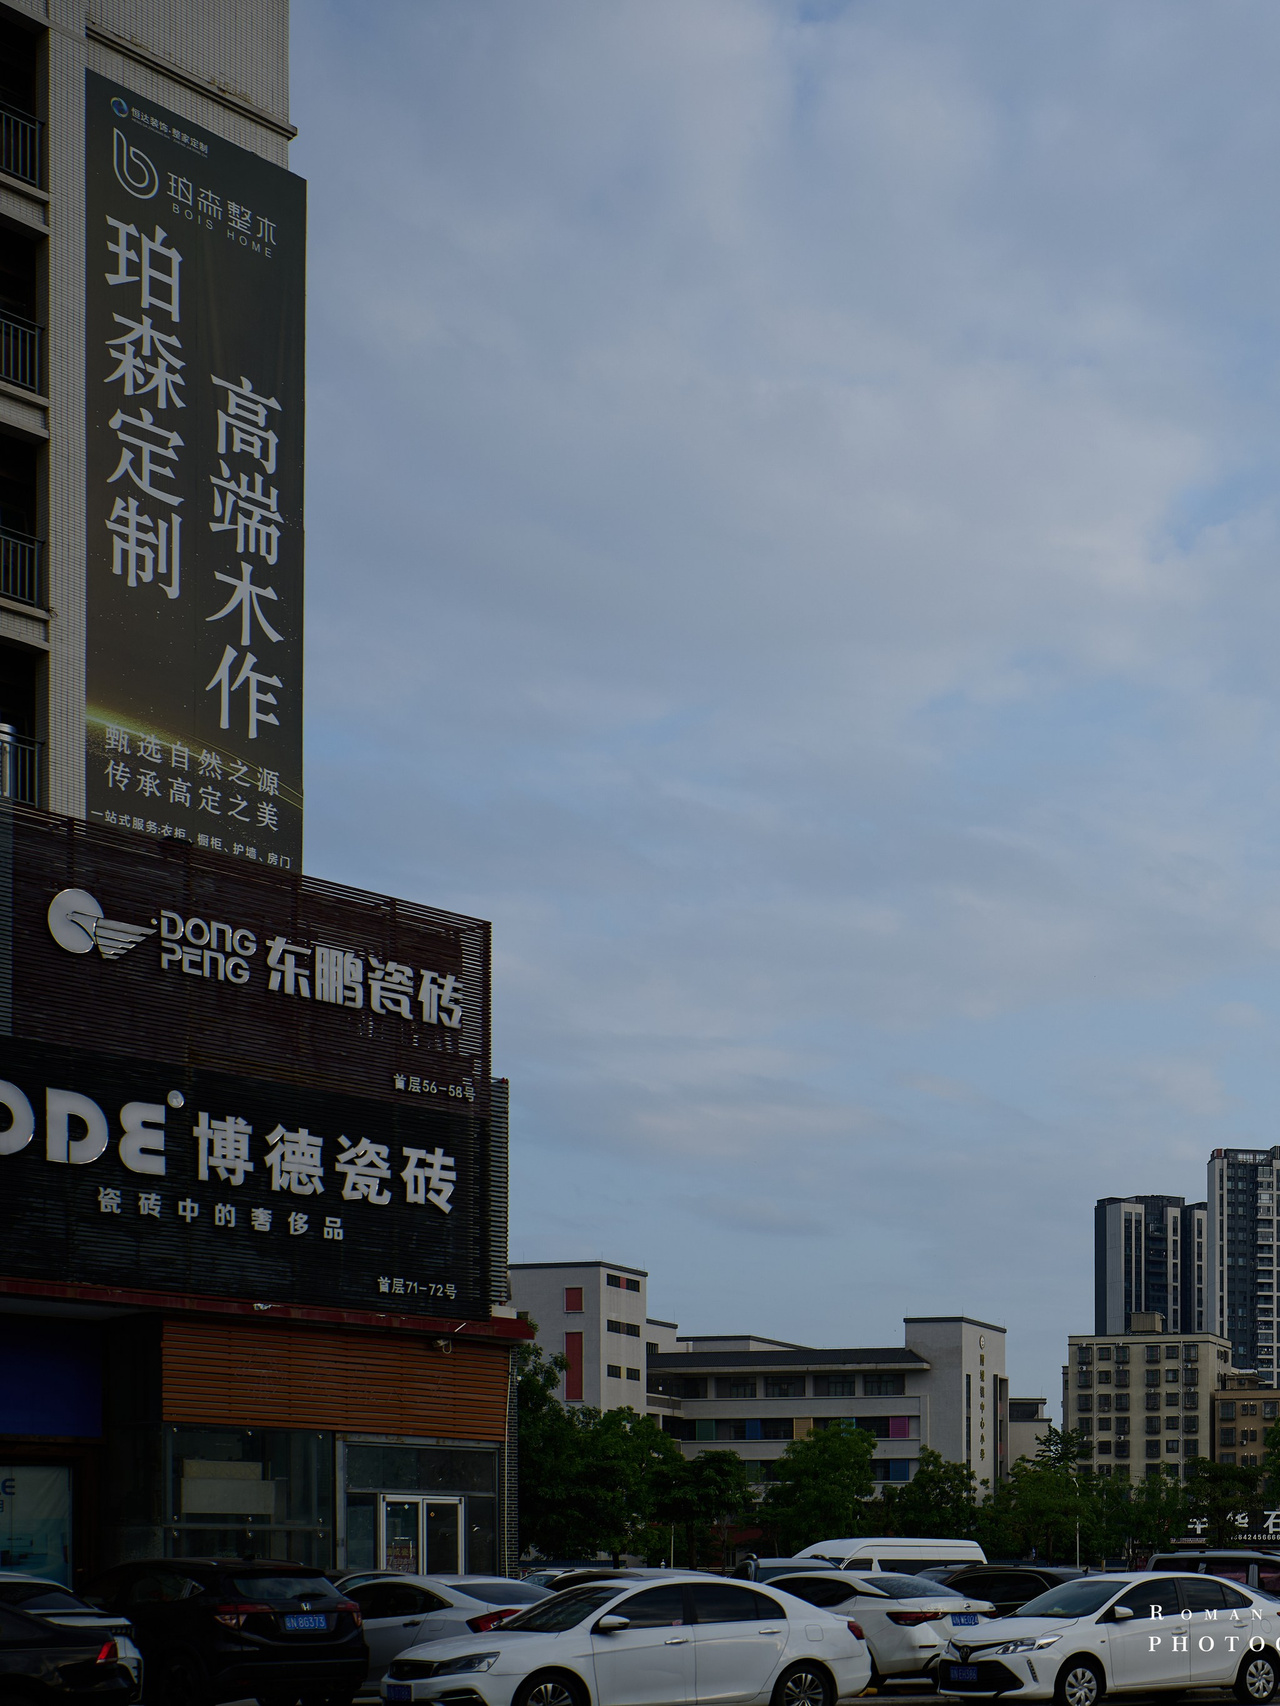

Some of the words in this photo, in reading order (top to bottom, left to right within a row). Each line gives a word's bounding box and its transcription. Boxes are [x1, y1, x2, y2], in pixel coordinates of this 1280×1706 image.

[172, 202, 214, 230] BOIS
[226, 229, 272, 259] HOME
[104, 214, 187, 600] 珀森定制
[207, 373, 285, 740] 高端木作
[103, 759, 280, 832] 传承高定之美
[104, 725, 280, 797] 甄选自然之源
[160, 909, 257, 957] DONG
[160, 940, 250, 985] PENG
[265, 935, 464, 1030] 东鹏瓷砖
[192, 1110, 458, 1215] 博德瓷砖
[97, 1186, 345, 1241] 瓷砖中的奢侈品
[377, 1276, 457, 1300] 首层71-72号
